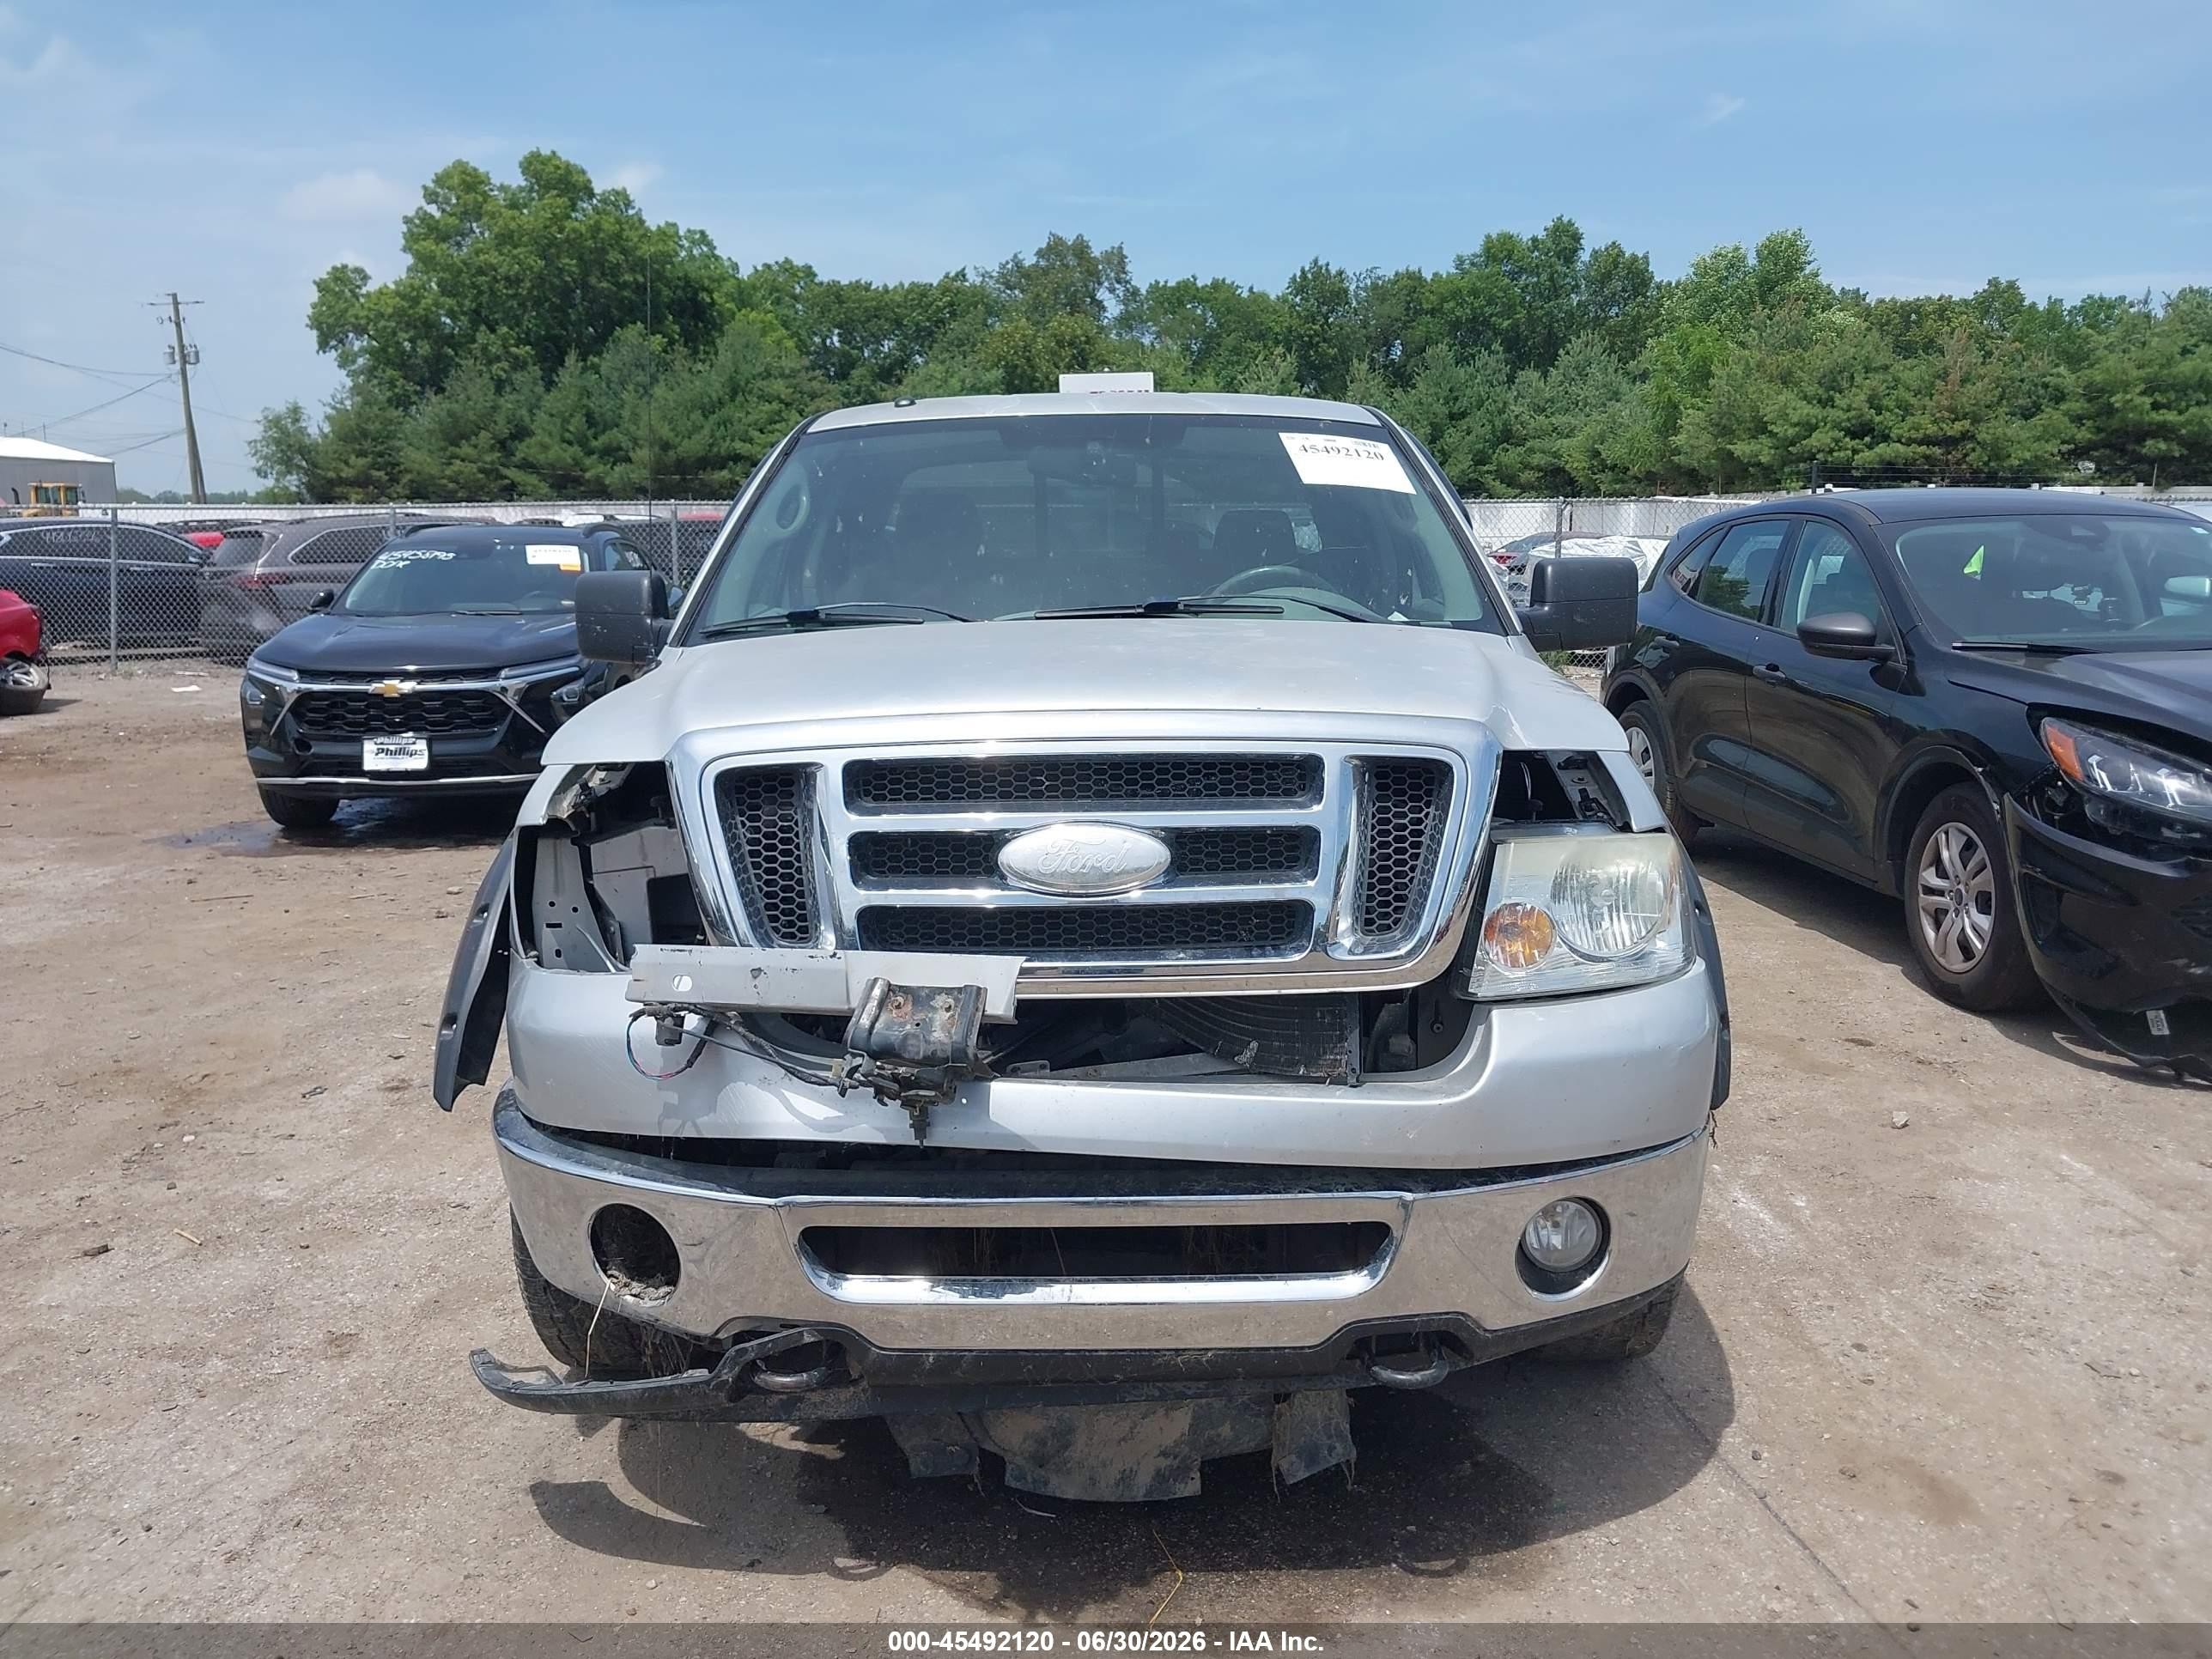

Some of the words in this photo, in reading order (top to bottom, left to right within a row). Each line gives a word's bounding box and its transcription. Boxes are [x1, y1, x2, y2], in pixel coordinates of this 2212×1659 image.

[1298, 444, 1384, 460] 45492120
[374, 746, 426, 757] Phillips
[1037, 839, 1133, 874] Ford
